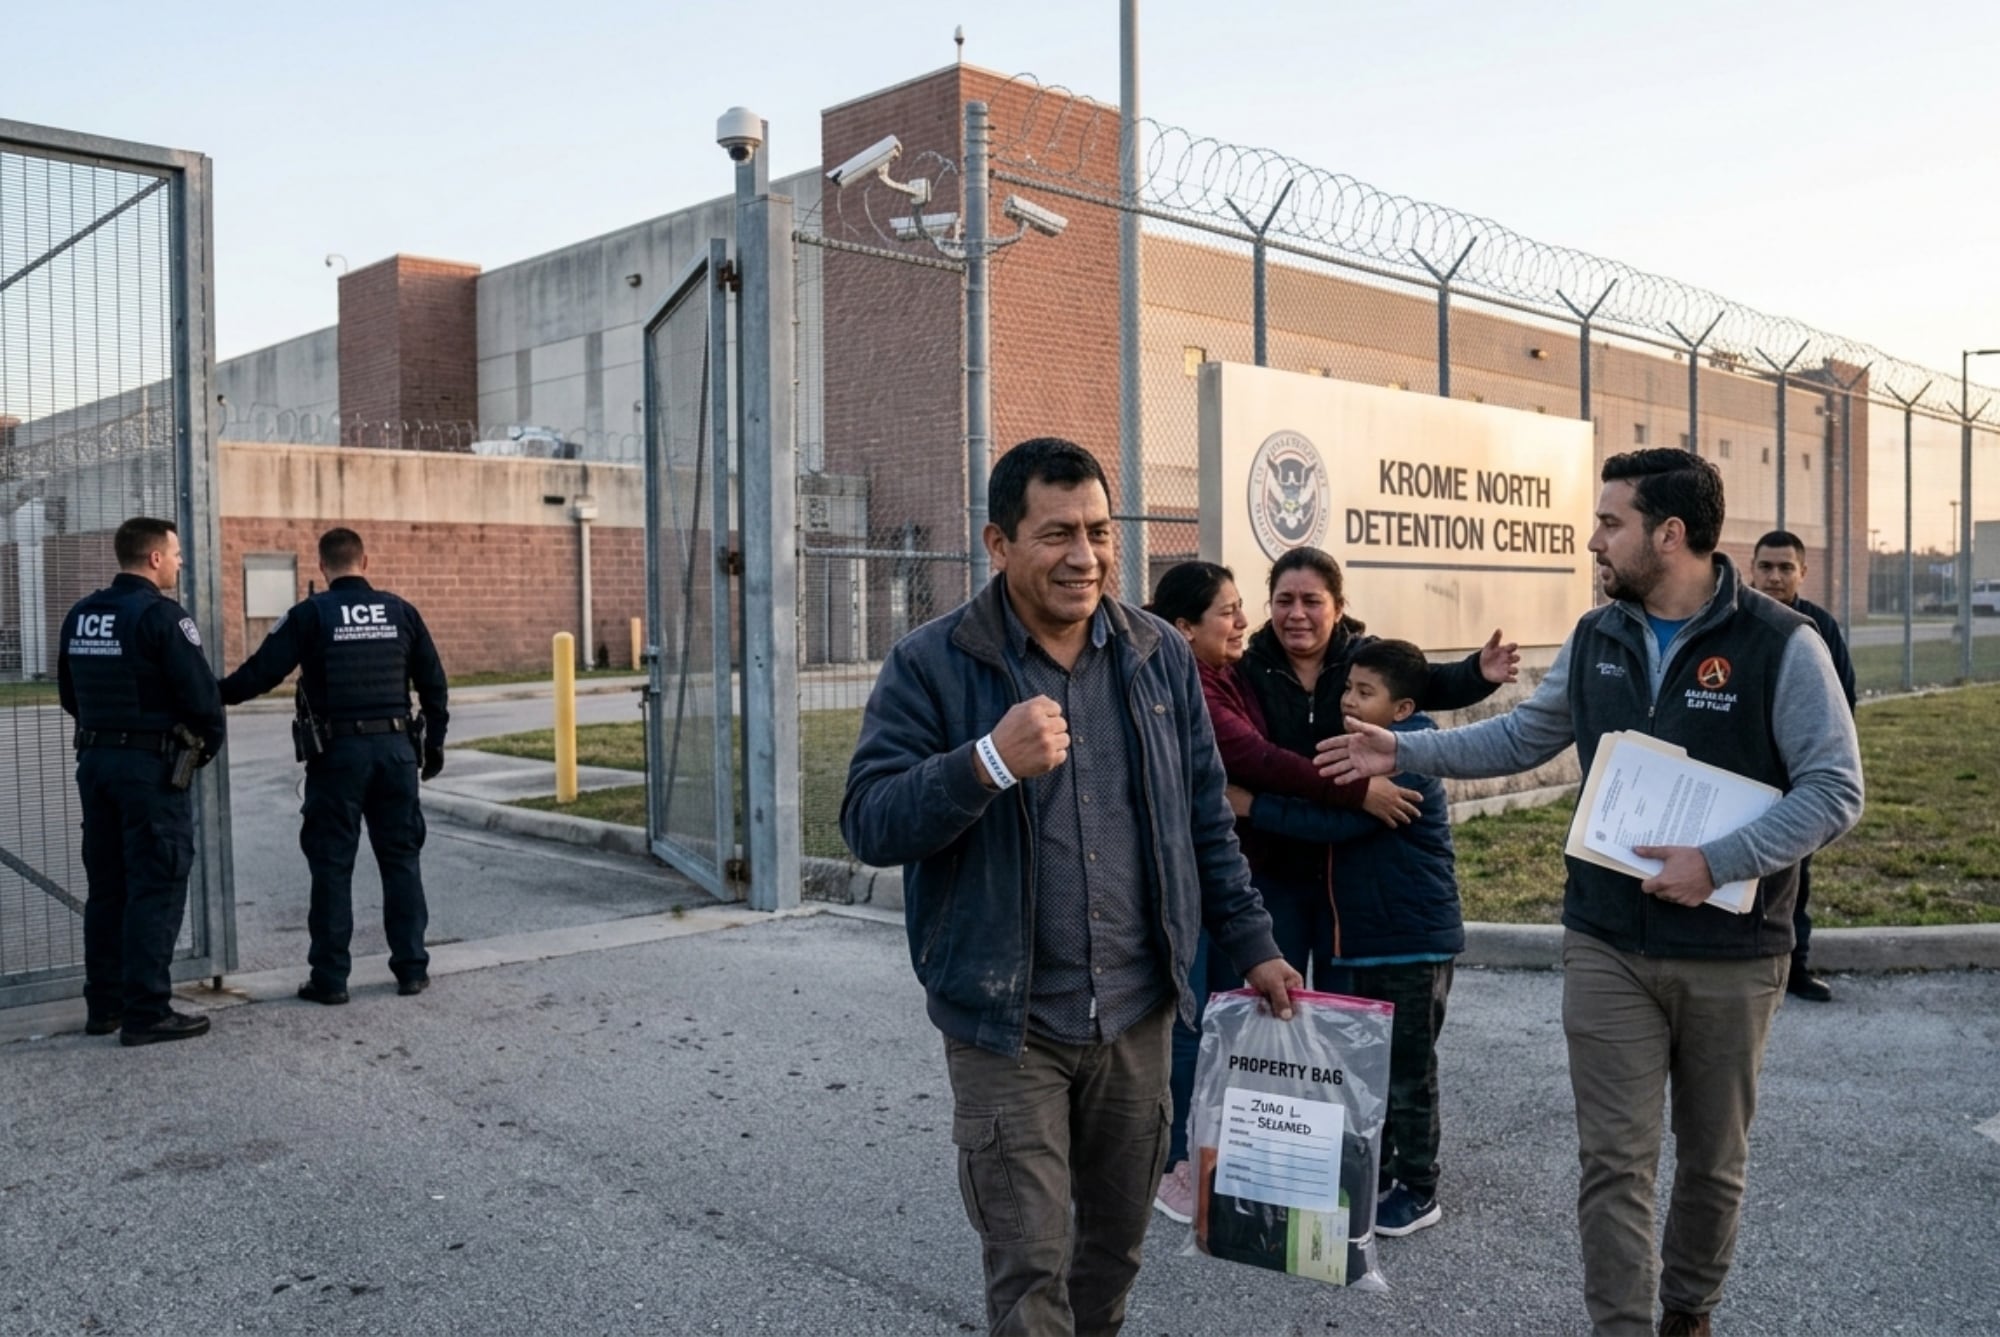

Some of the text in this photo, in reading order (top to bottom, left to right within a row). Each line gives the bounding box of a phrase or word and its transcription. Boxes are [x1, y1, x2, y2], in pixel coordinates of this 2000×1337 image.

[1379, 459, 1551, 508] KROME NORTH
[1346, 508, 1576, 555] DETENTION CENTER
[76, 614, 116, 638] ICE
[340, 603, 388, 625] ICE
[1229, 1055, 1344, 1086] PROPERTY BAG
